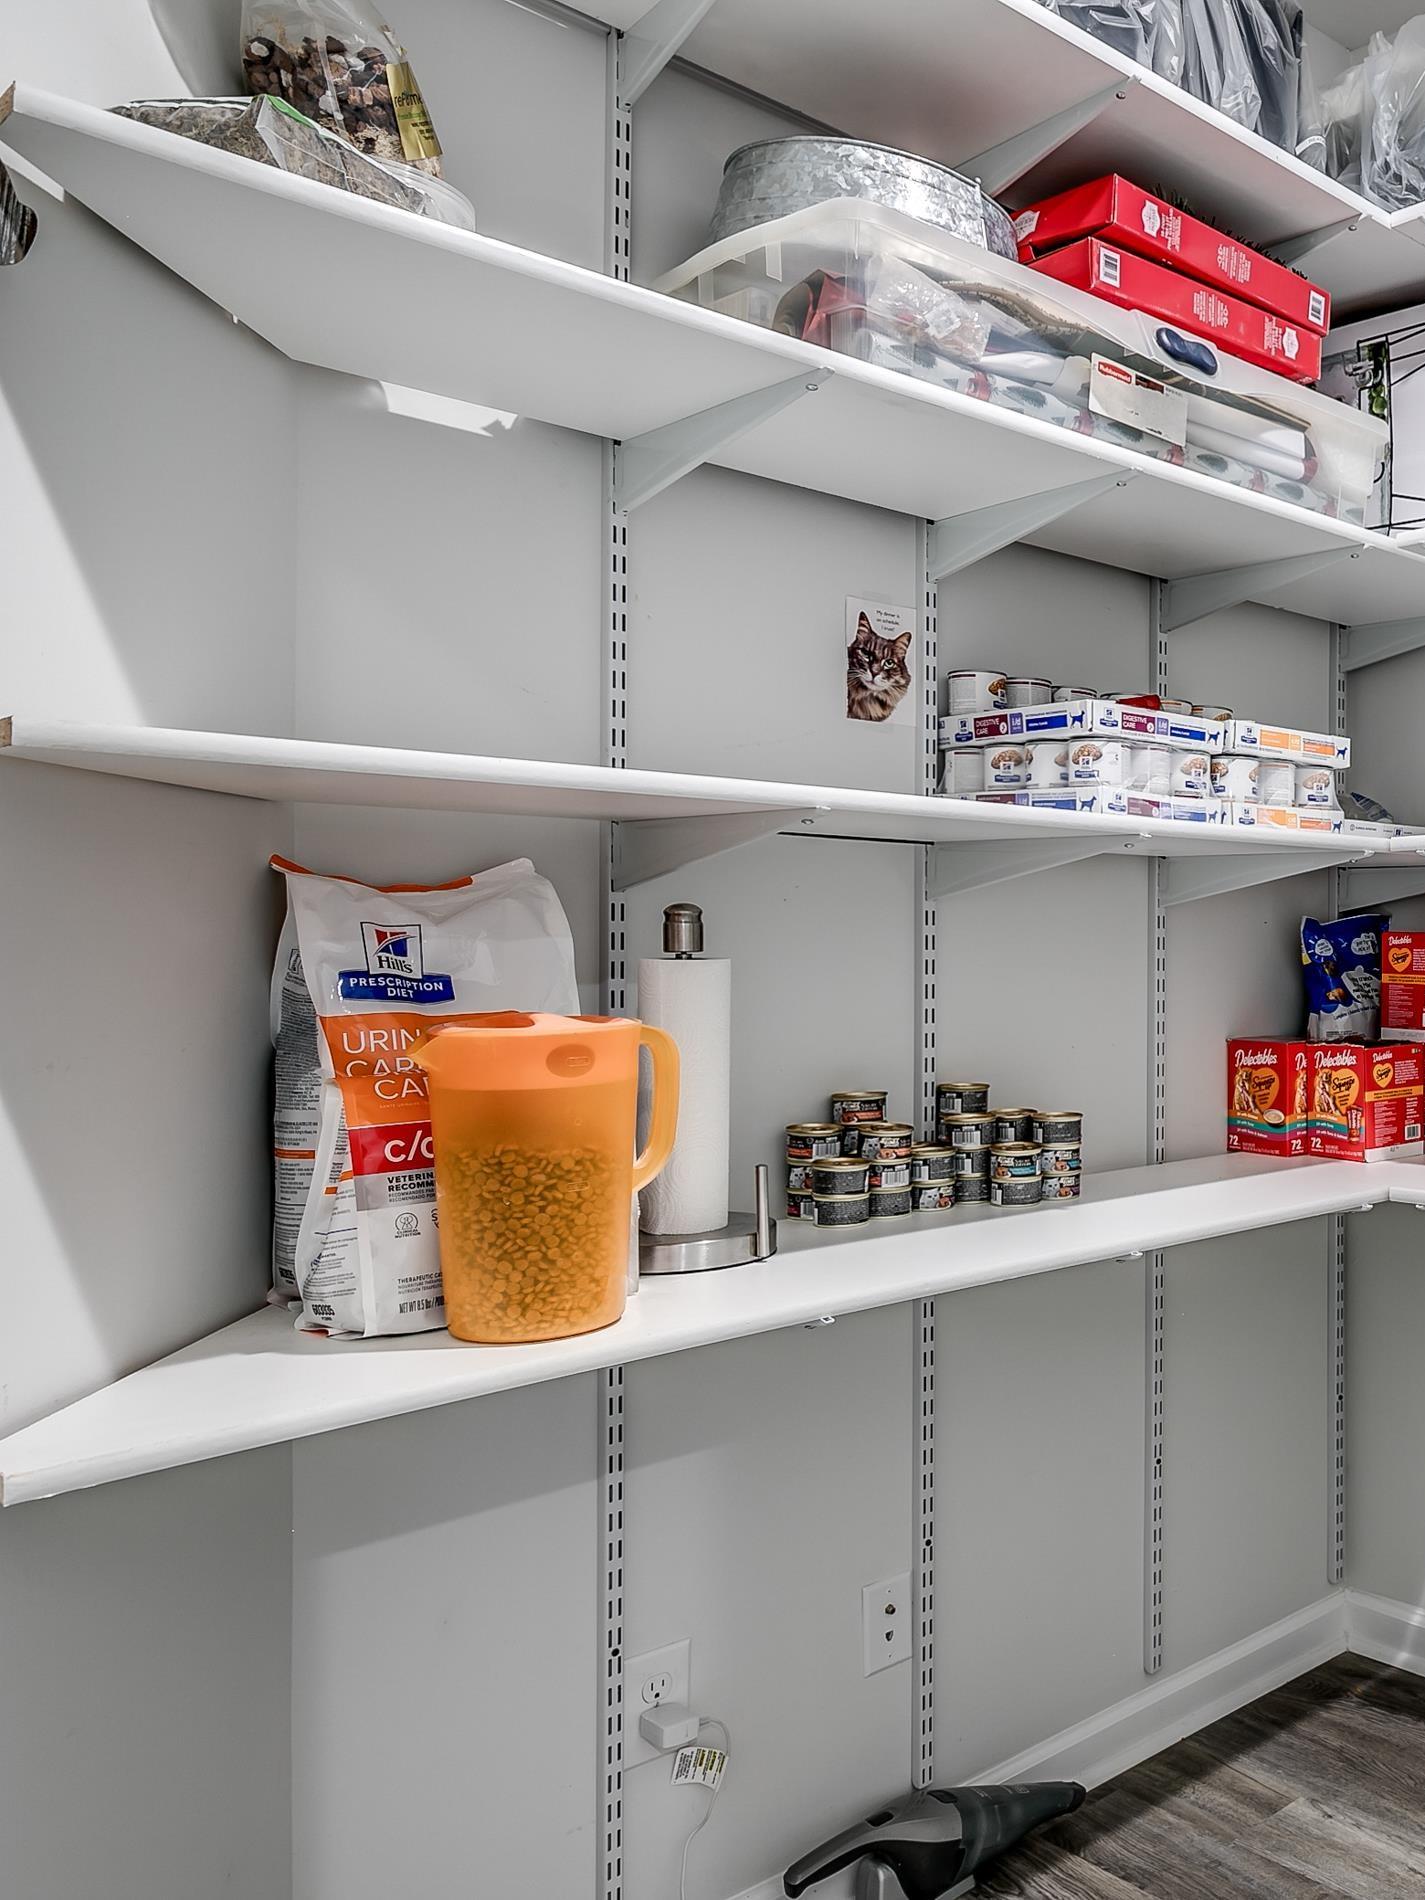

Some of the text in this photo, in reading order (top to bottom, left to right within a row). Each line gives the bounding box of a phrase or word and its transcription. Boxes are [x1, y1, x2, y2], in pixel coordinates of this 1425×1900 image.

[376, 956, 413, 974] Hill's
[350, 977, 444, 991] PRESCRIPTION
[387, 987, 413, 999] DIET
[342, 1028, 420, 1054] URIN
[1235, 1048, 1278, 1067] Delectables
[1314, 1049, 1357, 1069] Delectables
[346, 1057, 415, 1077] CAR
[374, 1076, 430, 1100] CA
[1229, 1135, 1239, 1145] 72
[1291, 1139, 1302, 1150] 72
[1311, 1137, 1322, 1148] 72
[387, 1171, 434, 1184] VETERIN
[388, 1180, 435, 1192] RECOMM
